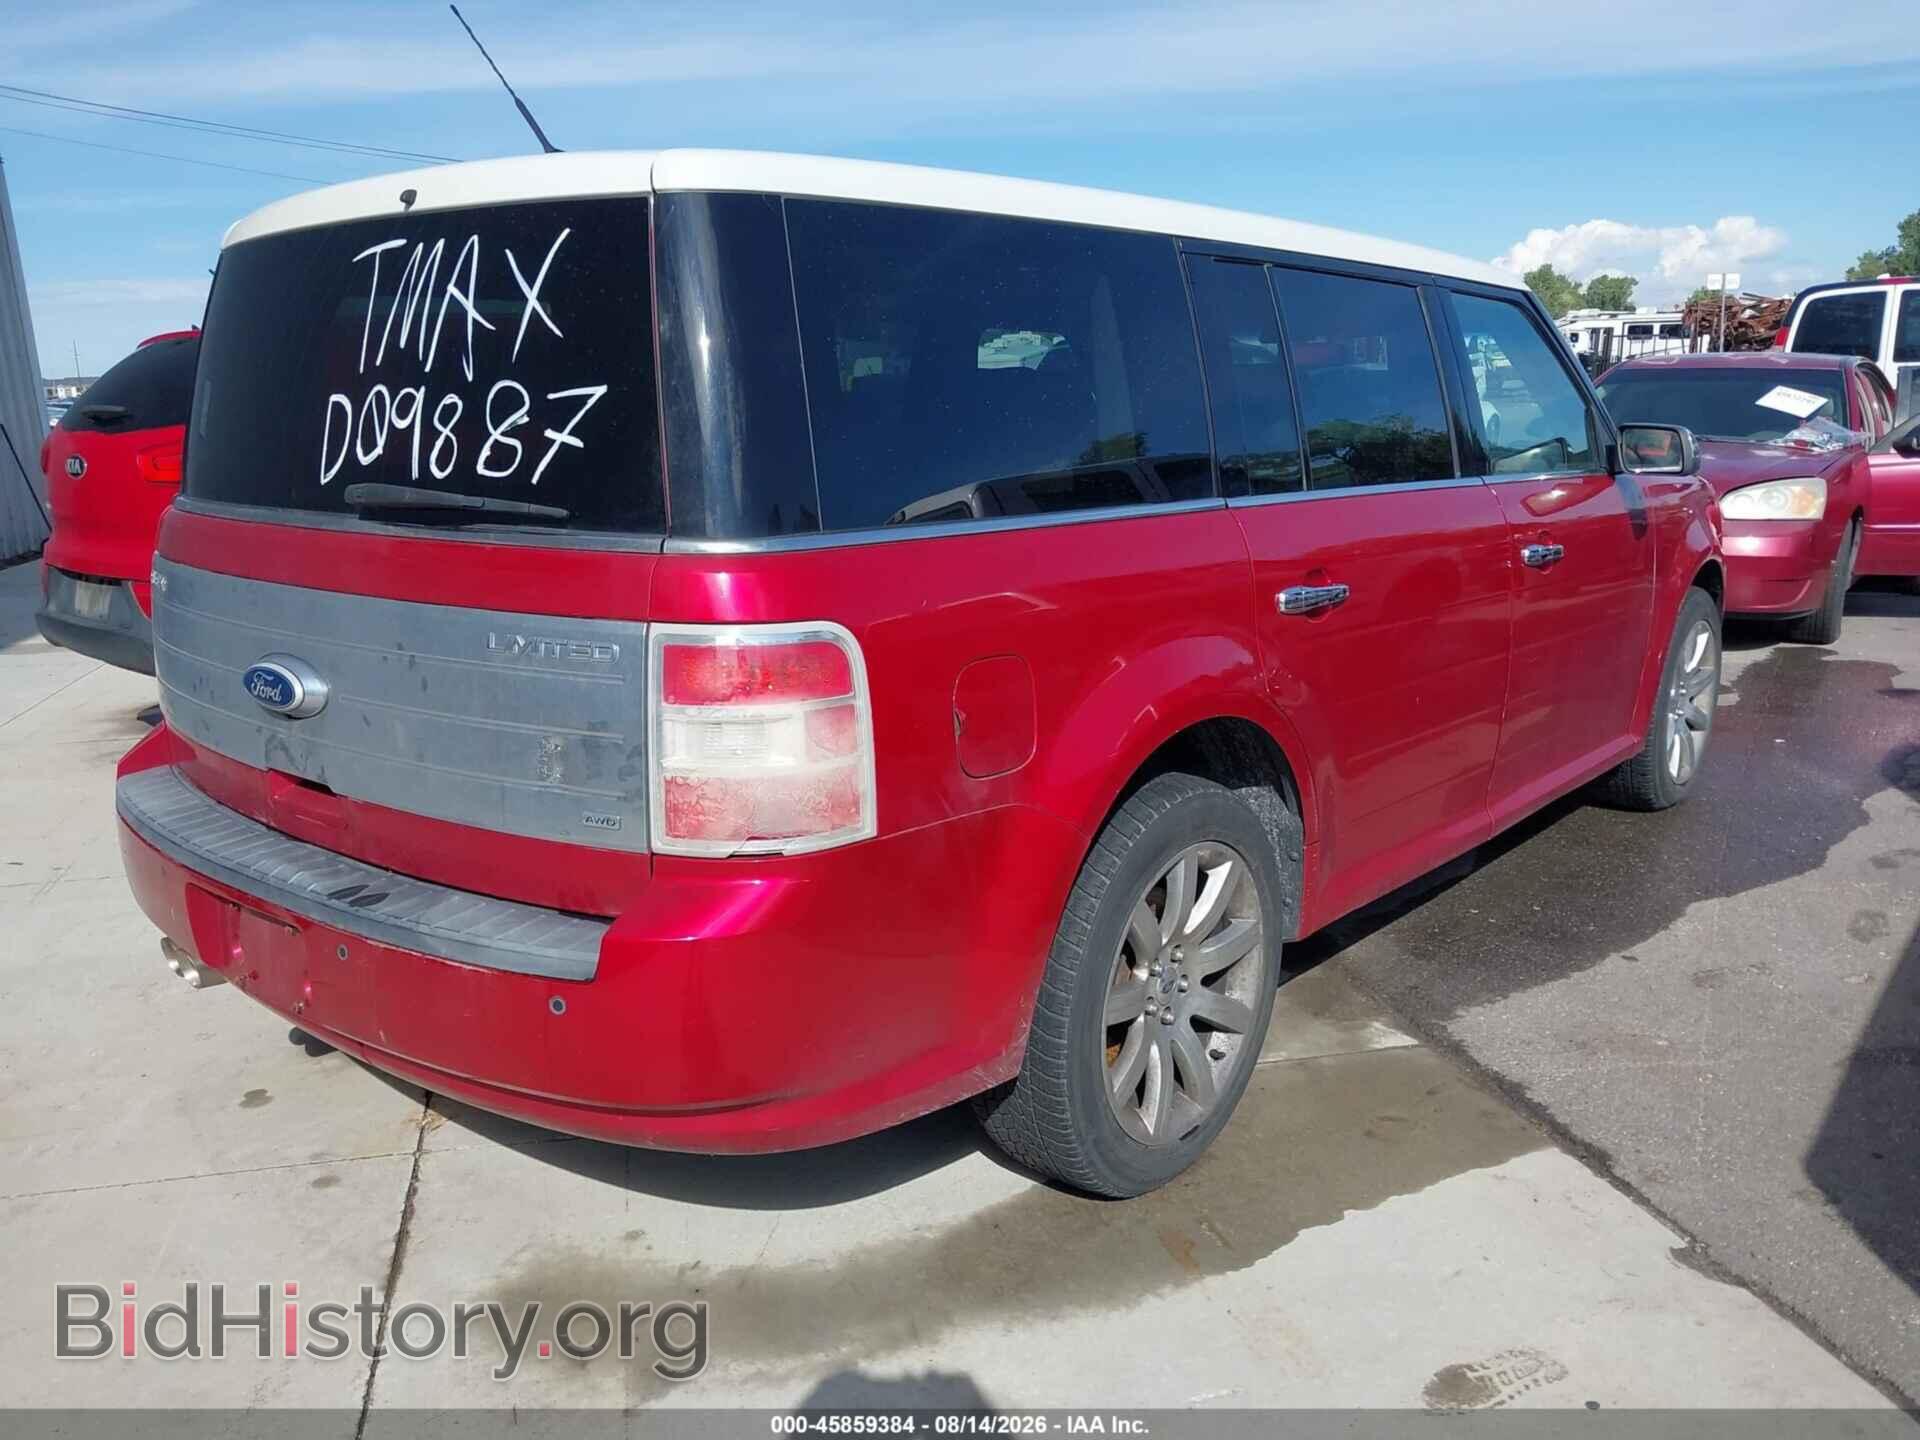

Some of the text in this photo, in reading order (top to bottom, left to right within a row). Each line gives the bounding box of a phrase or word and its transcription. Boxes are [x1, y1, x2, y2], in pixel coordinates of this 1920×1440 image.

[352, 227, 571, 382] TMAX
[487, 631, 622, 664] LIMITED
[251, 671, 283, 703] Ford
[584, 815, 617, 827] AWD
